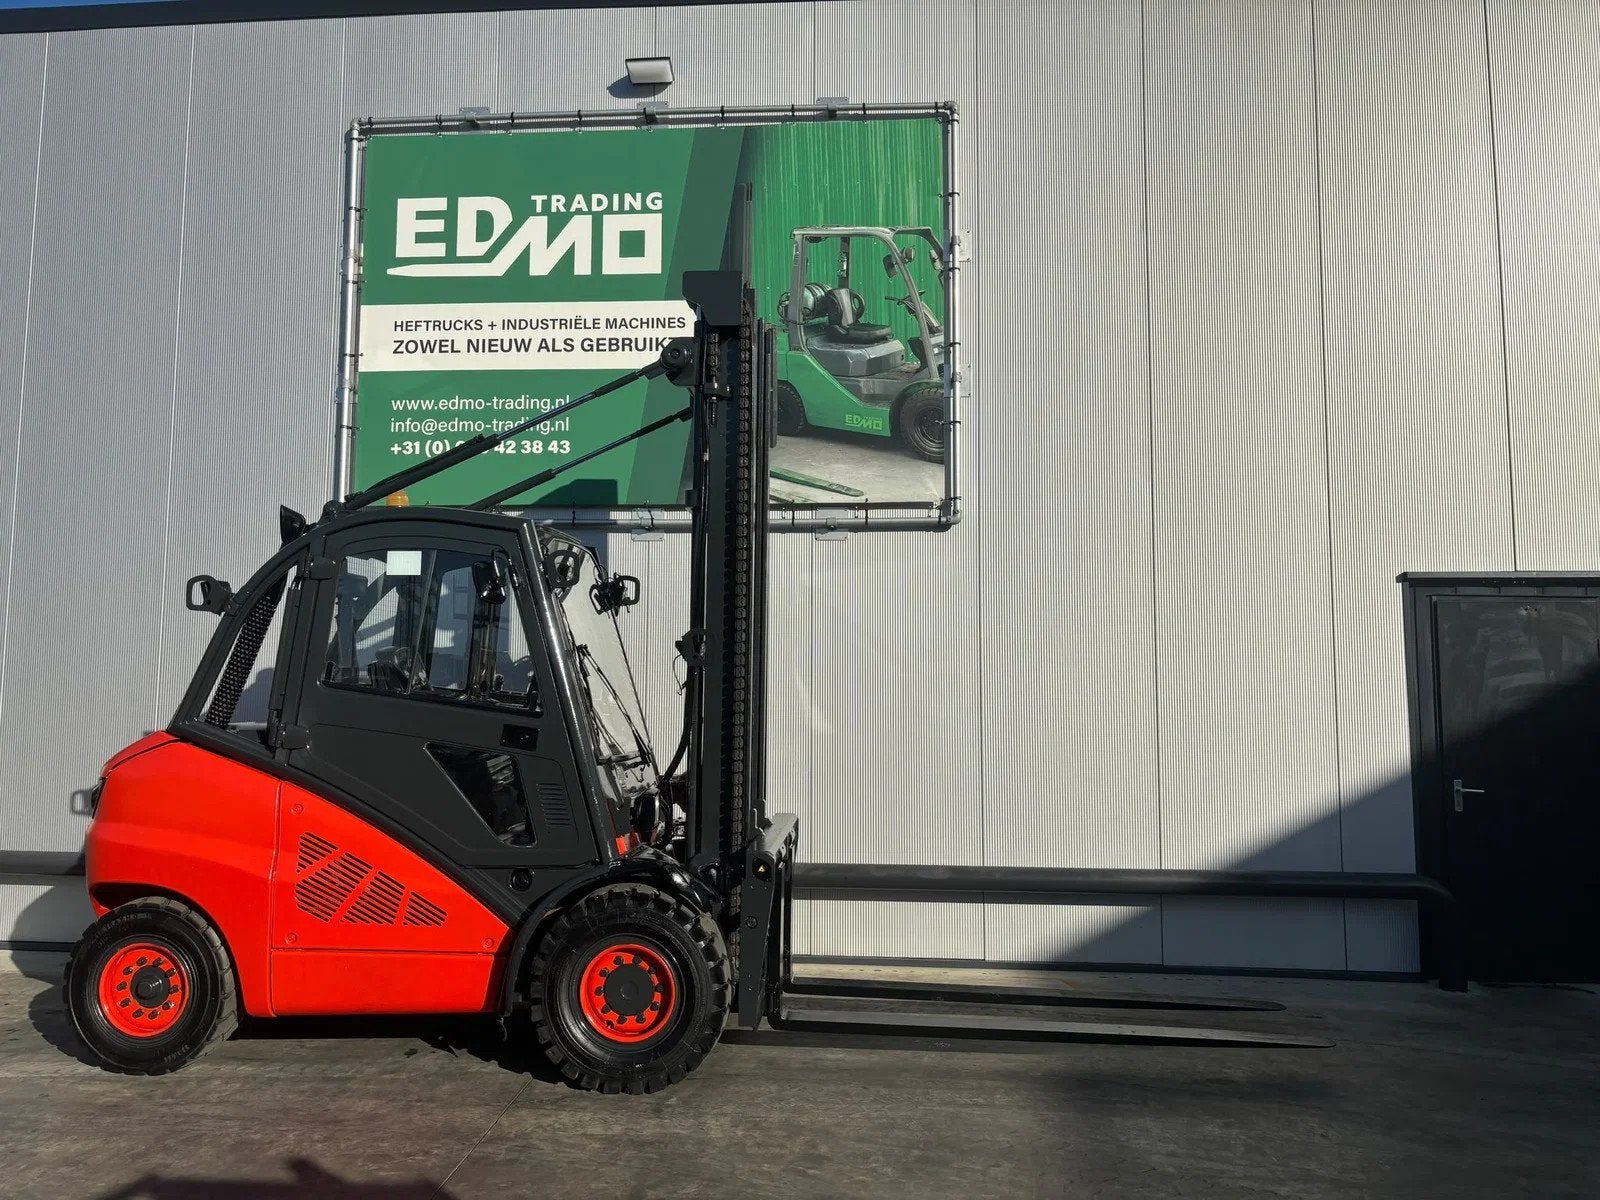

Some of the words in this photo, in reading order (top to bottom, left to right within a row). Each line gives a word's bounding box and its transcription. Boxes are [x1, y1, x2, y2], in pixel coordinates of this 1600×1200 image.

[531, 192, 663, 213] TRADING
[387, 196, 663, 277] EDMO
[393, 319, 483, 332] HEFTRUCKS
[488, 320, 497, 330] +
[501, 315, 601, 330] INDUSTRIËLE
[605, 317, 686, 330] MACHINES
[392, 339, 461, 354] ZOWEL
[466, 338, 532, 353] NIEUW
[537, 338, 575, 353] ALS
[580, 336, 674, 352] GEBRUIK
[391, 394, 570, 413] www.edmo-trading.nl
[845, 414, 883, 430] EDMO
[390, 440, 420, 455] +31
[424, 439, 450, 458] (0)
[494, 440, 516, 454] 42
[520, 440, 543, 454] 38
[549, 440, 571, 454] 43
